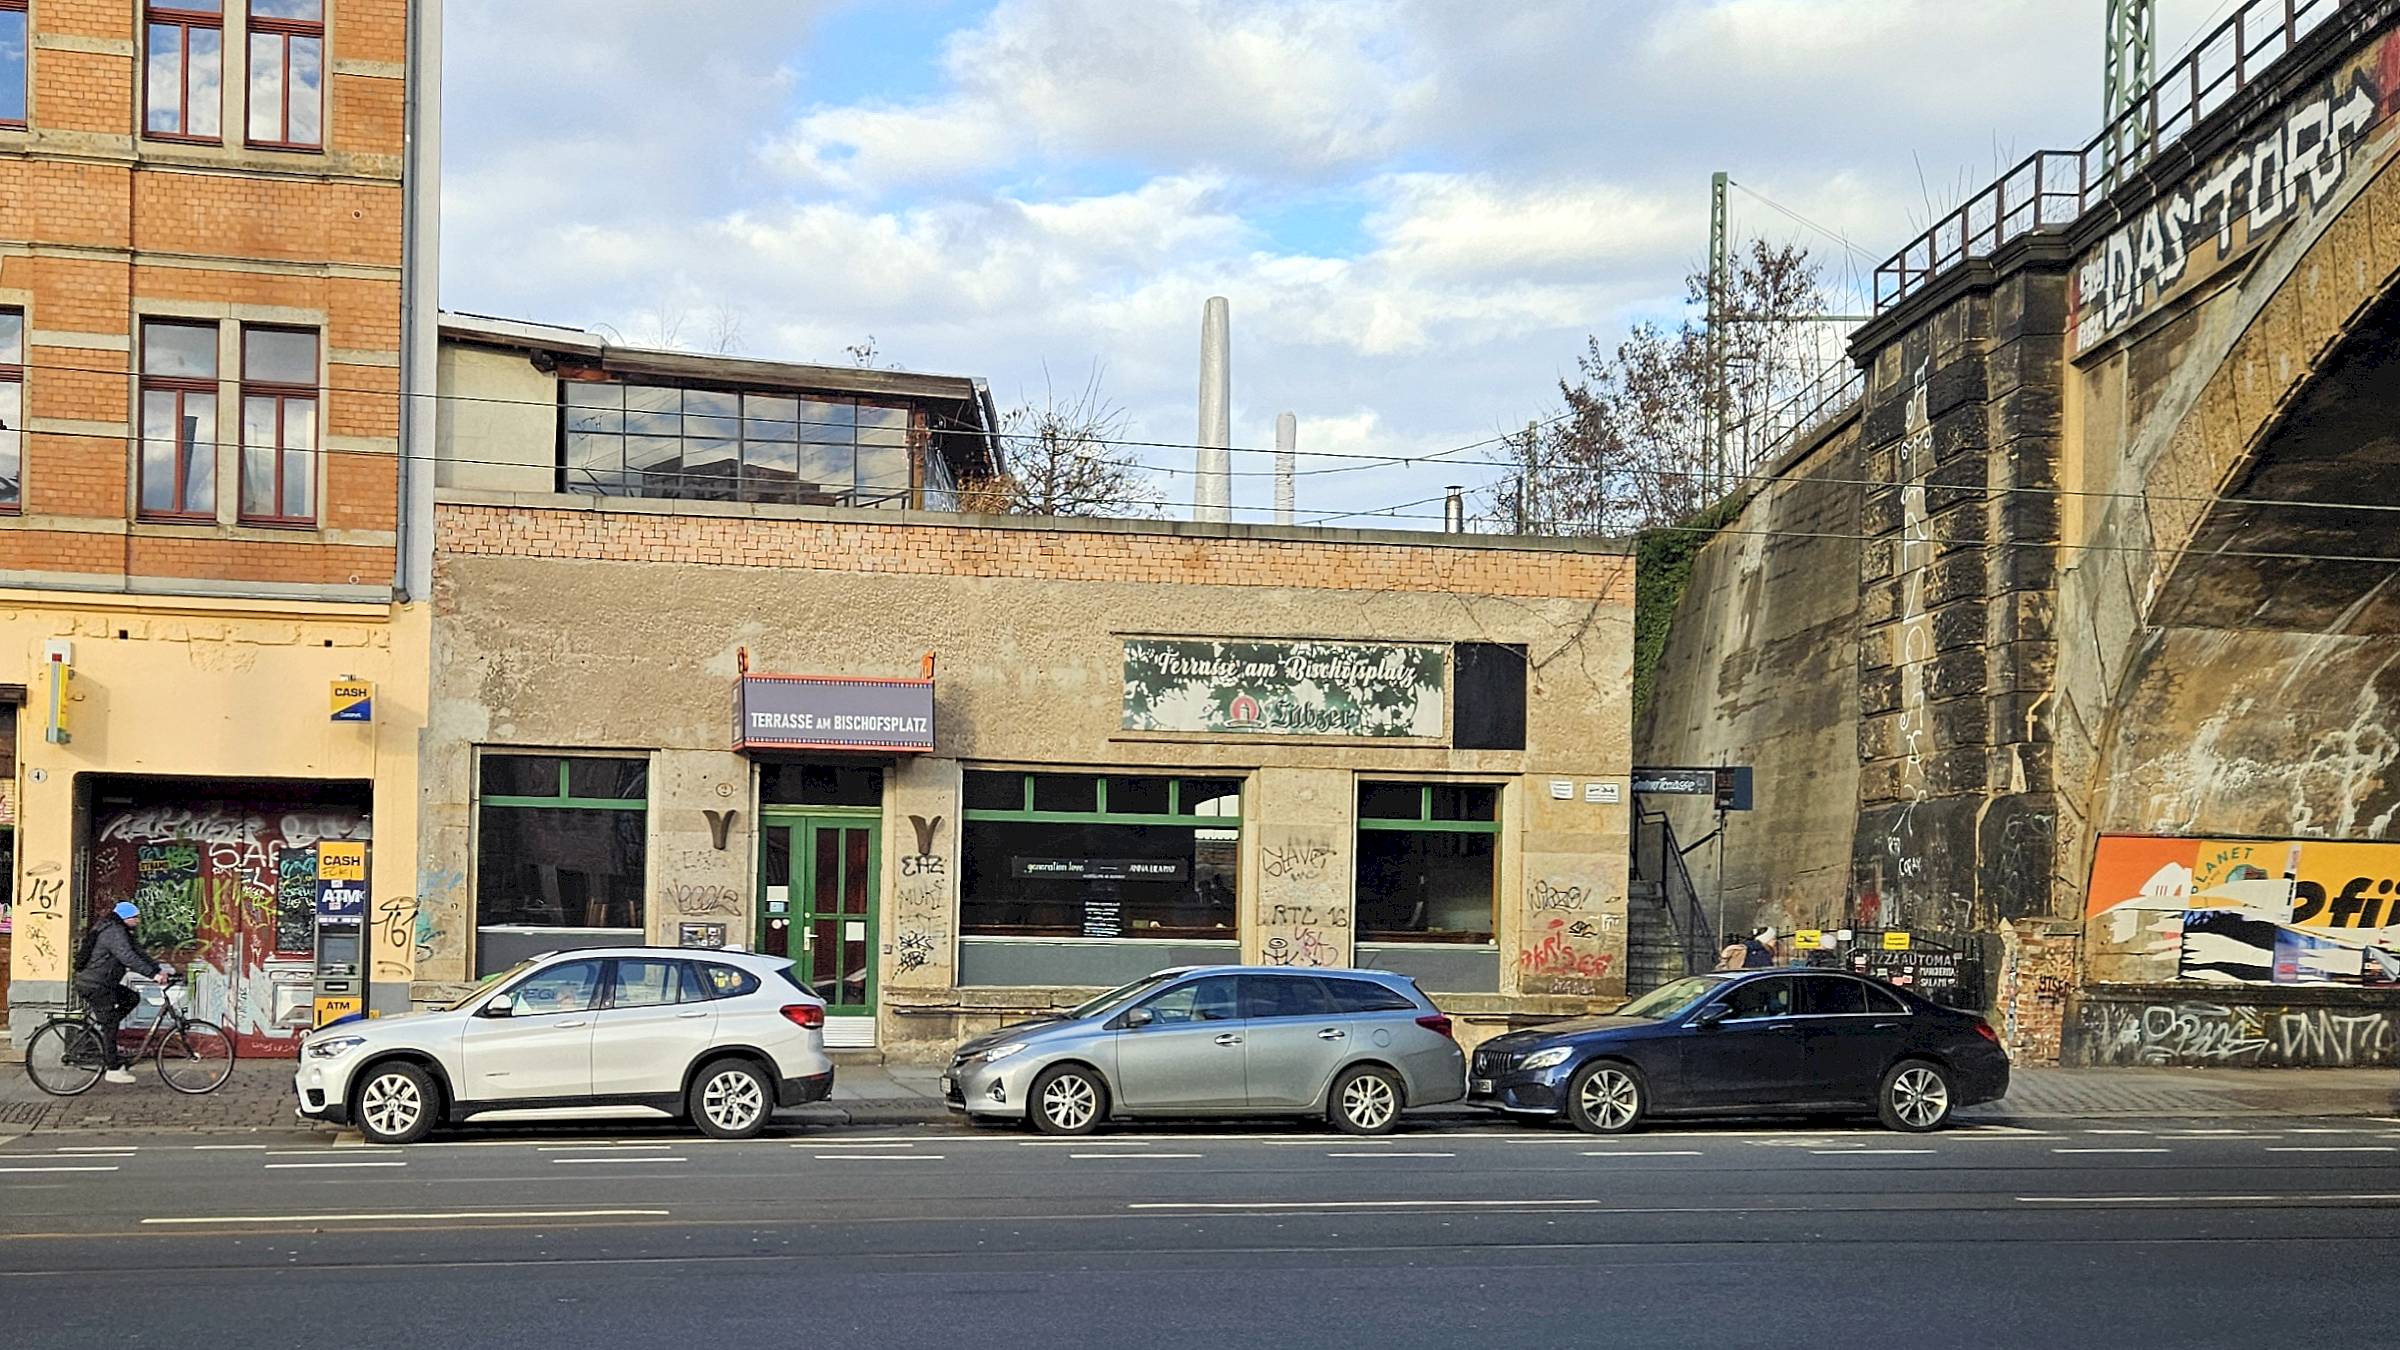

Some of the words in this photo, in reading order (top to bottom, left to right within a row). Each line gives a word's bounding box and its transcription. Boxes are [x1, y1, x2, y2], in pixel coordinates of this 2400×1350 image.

[1157, 650, 1239, 678] Terrasse
[1244, 663, 1278, 680] am
[1284, 655, 1418, 688] Bischofsplatz
[334, 687, 368, 697] CASH
[750, 712, 814, 729] TERRASSE
[816, 717, 832, 730] AM
[833, 715, 928, 733] BISCHOFSPLATZ
[322, 855, 361, 867] CASH
[321, 888, 361, 904] ATM
[326, 1001, 351, 1011] ATM
